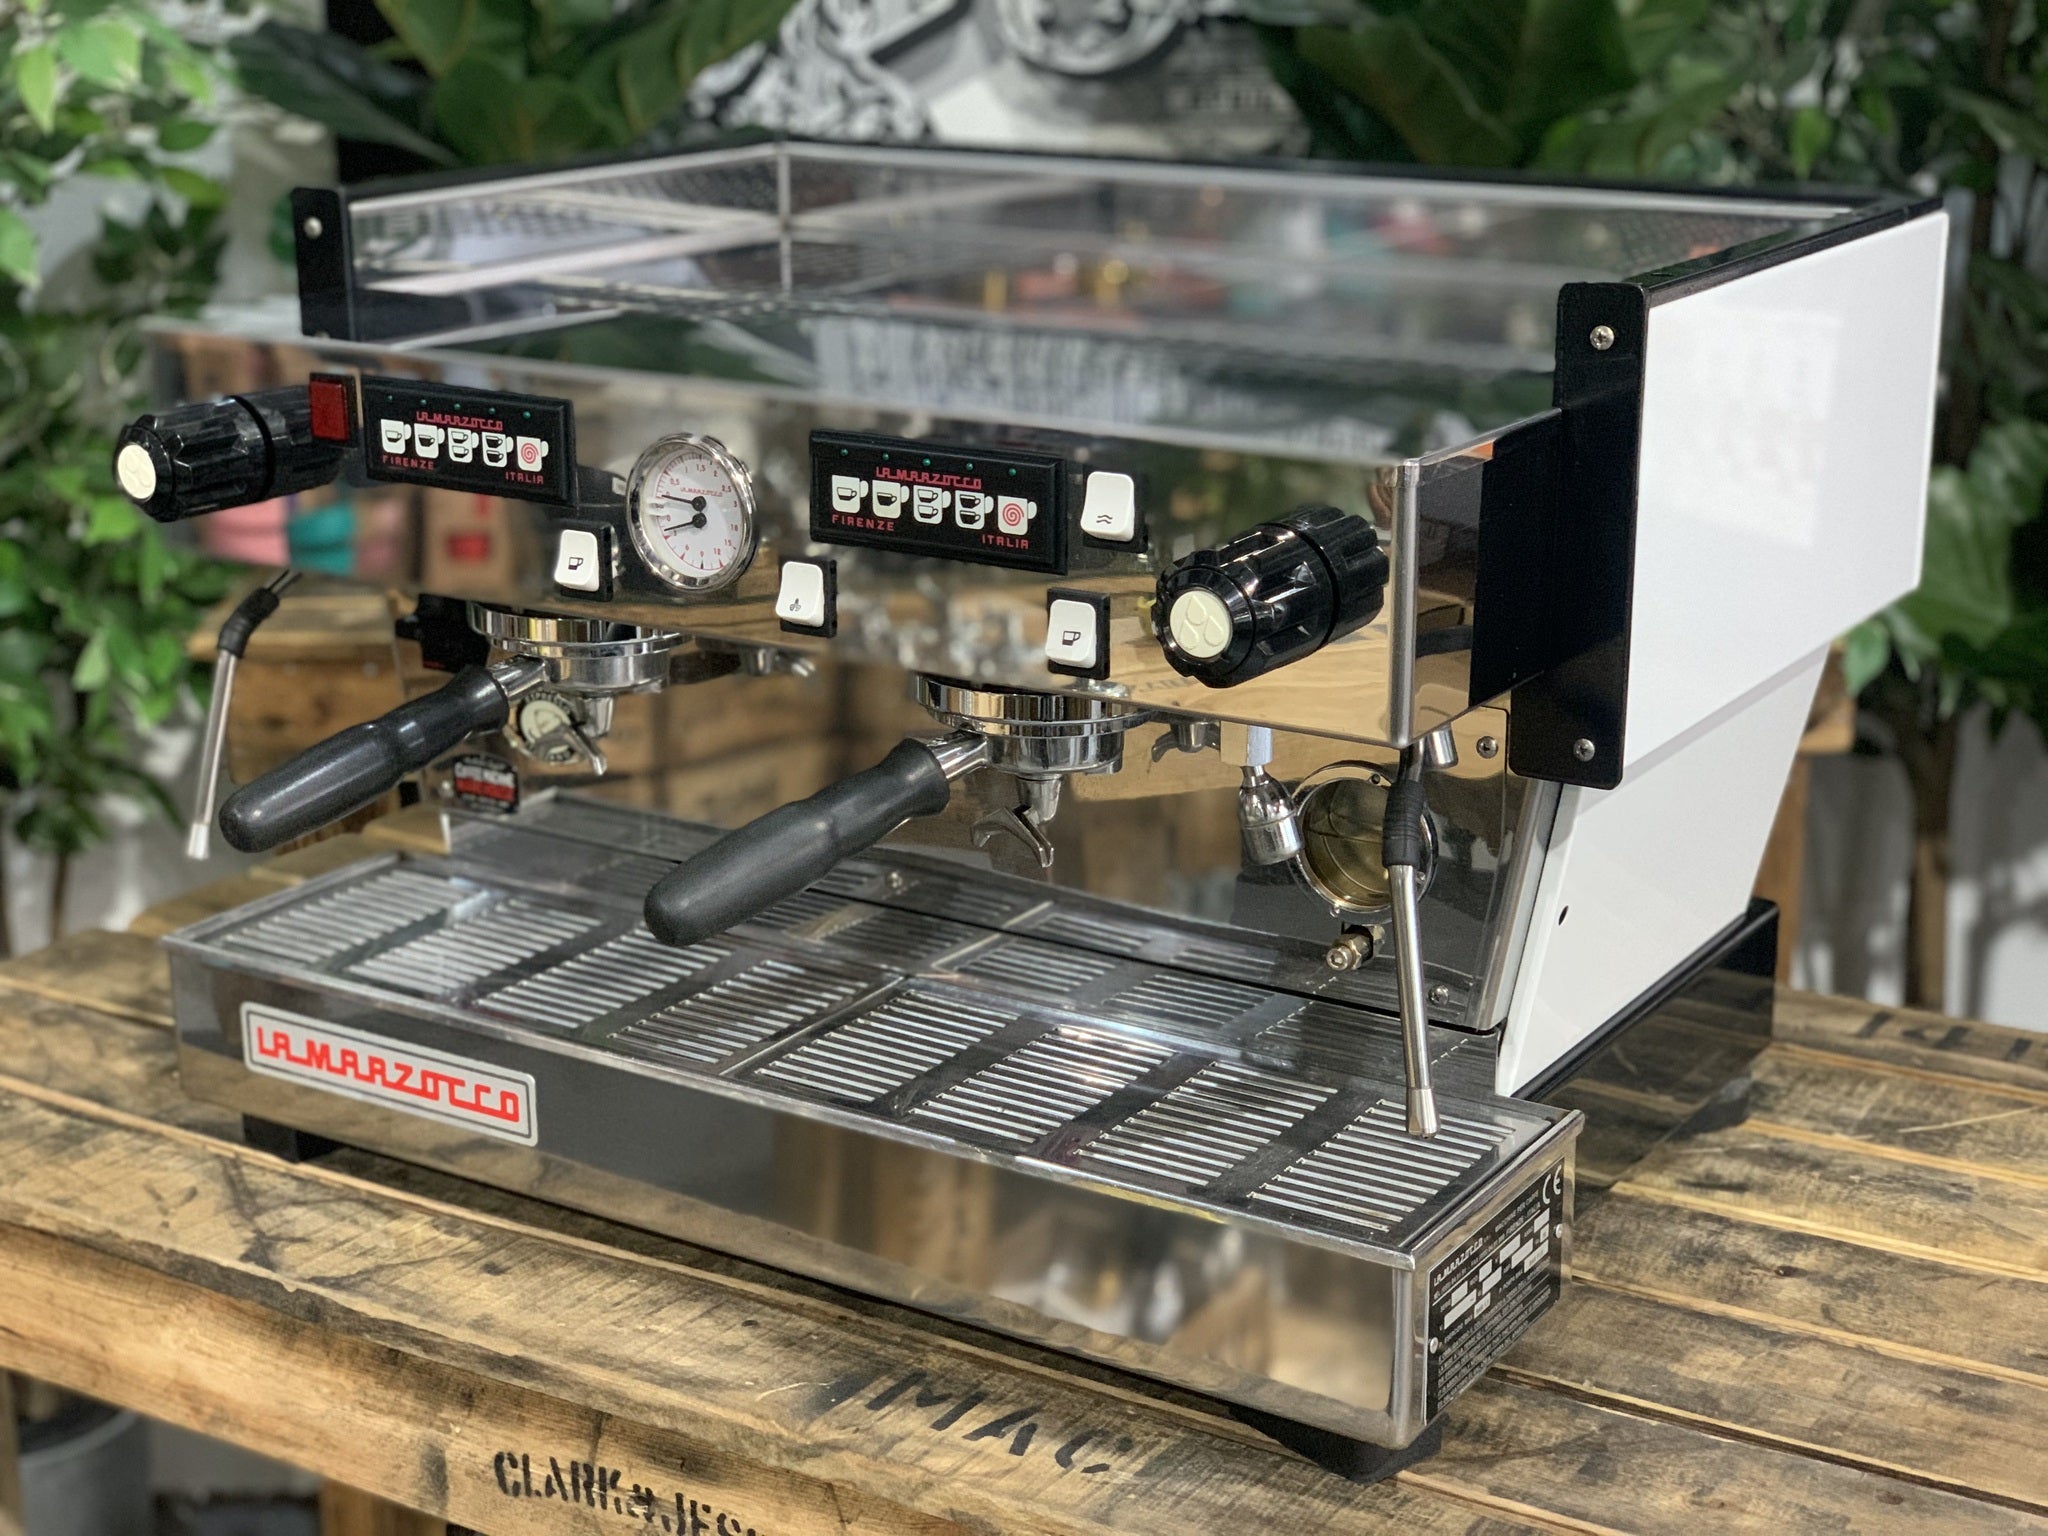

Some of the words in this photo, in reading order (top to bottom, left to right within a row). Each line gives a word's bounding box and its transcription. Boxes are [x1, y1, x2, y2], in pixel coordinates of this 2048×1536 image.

[382, 454, 435, 470] FIRENZE
[504, 471, 545, 485] ITALIA
[831, 513, 896, 532] FIRENZE
[981, 533, 1029, 550] ITALIA
[256, 1025, 290, 1061] LA
[305, 1038, 520, 1123] MARZOCCO
